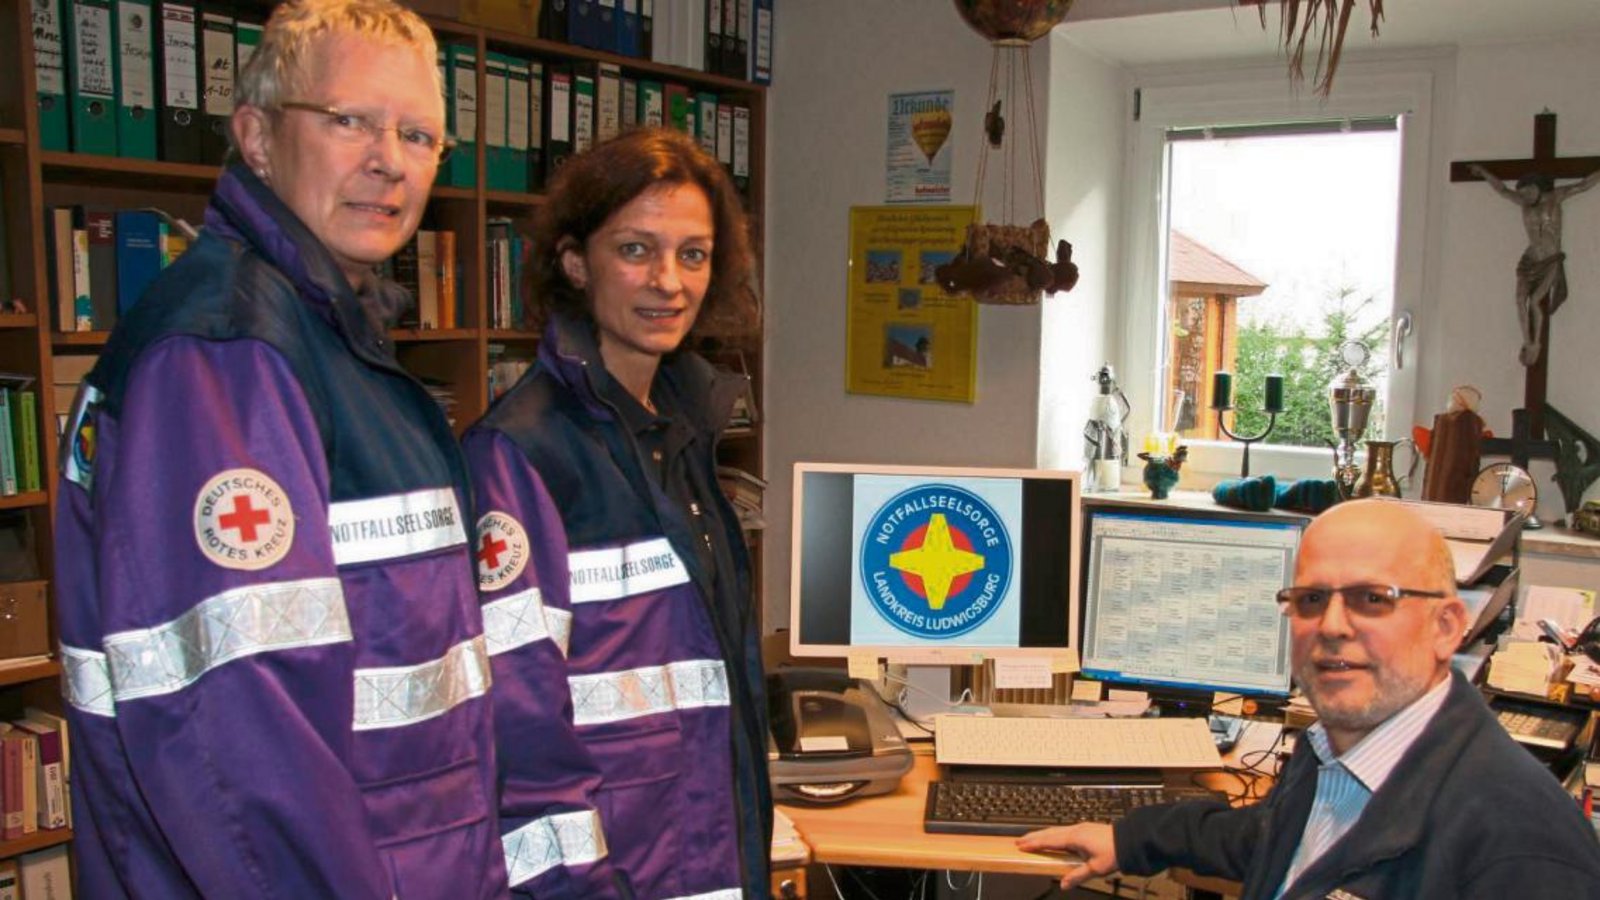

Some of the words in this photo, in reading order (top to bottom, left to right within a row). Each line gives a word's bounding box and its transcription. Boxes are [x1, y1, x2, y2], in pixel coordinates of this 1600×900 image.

[202, 477, 280, 517] DEUTSCHES
[203, 527, 249, 560] ROTES
[255, 518, 287, 558] KREUZ
[330, 506, 455, 543] NOTFALLSEELSORGE
[876, 495, 999, 548] NOTFALLSEELSORGE
[497, 543, 521, 580] KREUZ
[873, 571, 925, 628] LANDKREIS
[926, 573, 1000, 630] LUDWIGSBURG
